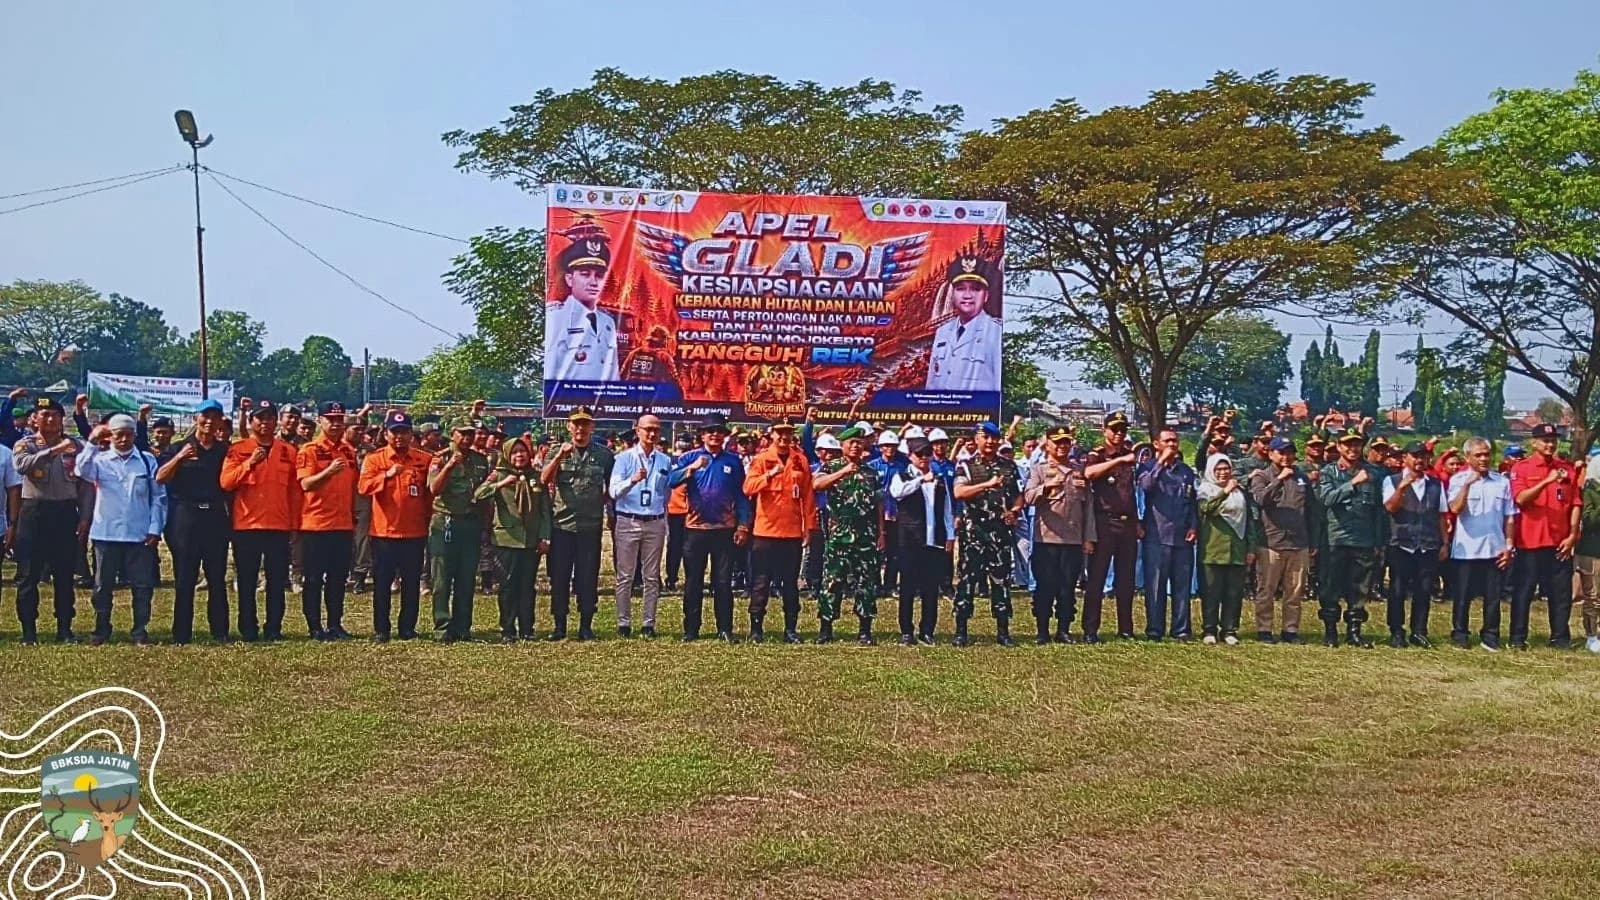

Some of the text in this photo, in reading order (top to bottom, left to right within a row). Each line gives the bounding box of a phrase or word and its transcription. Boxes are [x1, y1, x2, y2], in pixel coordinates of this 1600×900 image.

[713, 211, 841, 239] APEL
[681, 238, 885, 279] GLADI
[682, 274, 884, 298] KESIAPSIAGAAN
[675, 294, 895, 313] KEBAKARAN HUTAN DAN LAHAN
[693, 309, 876, 325] SERTA PERTOLONGAN LAKA AIR
[713, 322, 840, 334] DAN LAUNCHING
[678, 331, 874, 345] KABUPATEN MOJOKERTO
[677, 344, 873, 364] TANGGUH REK
[604, 405, 643, 413] TANGKAS
